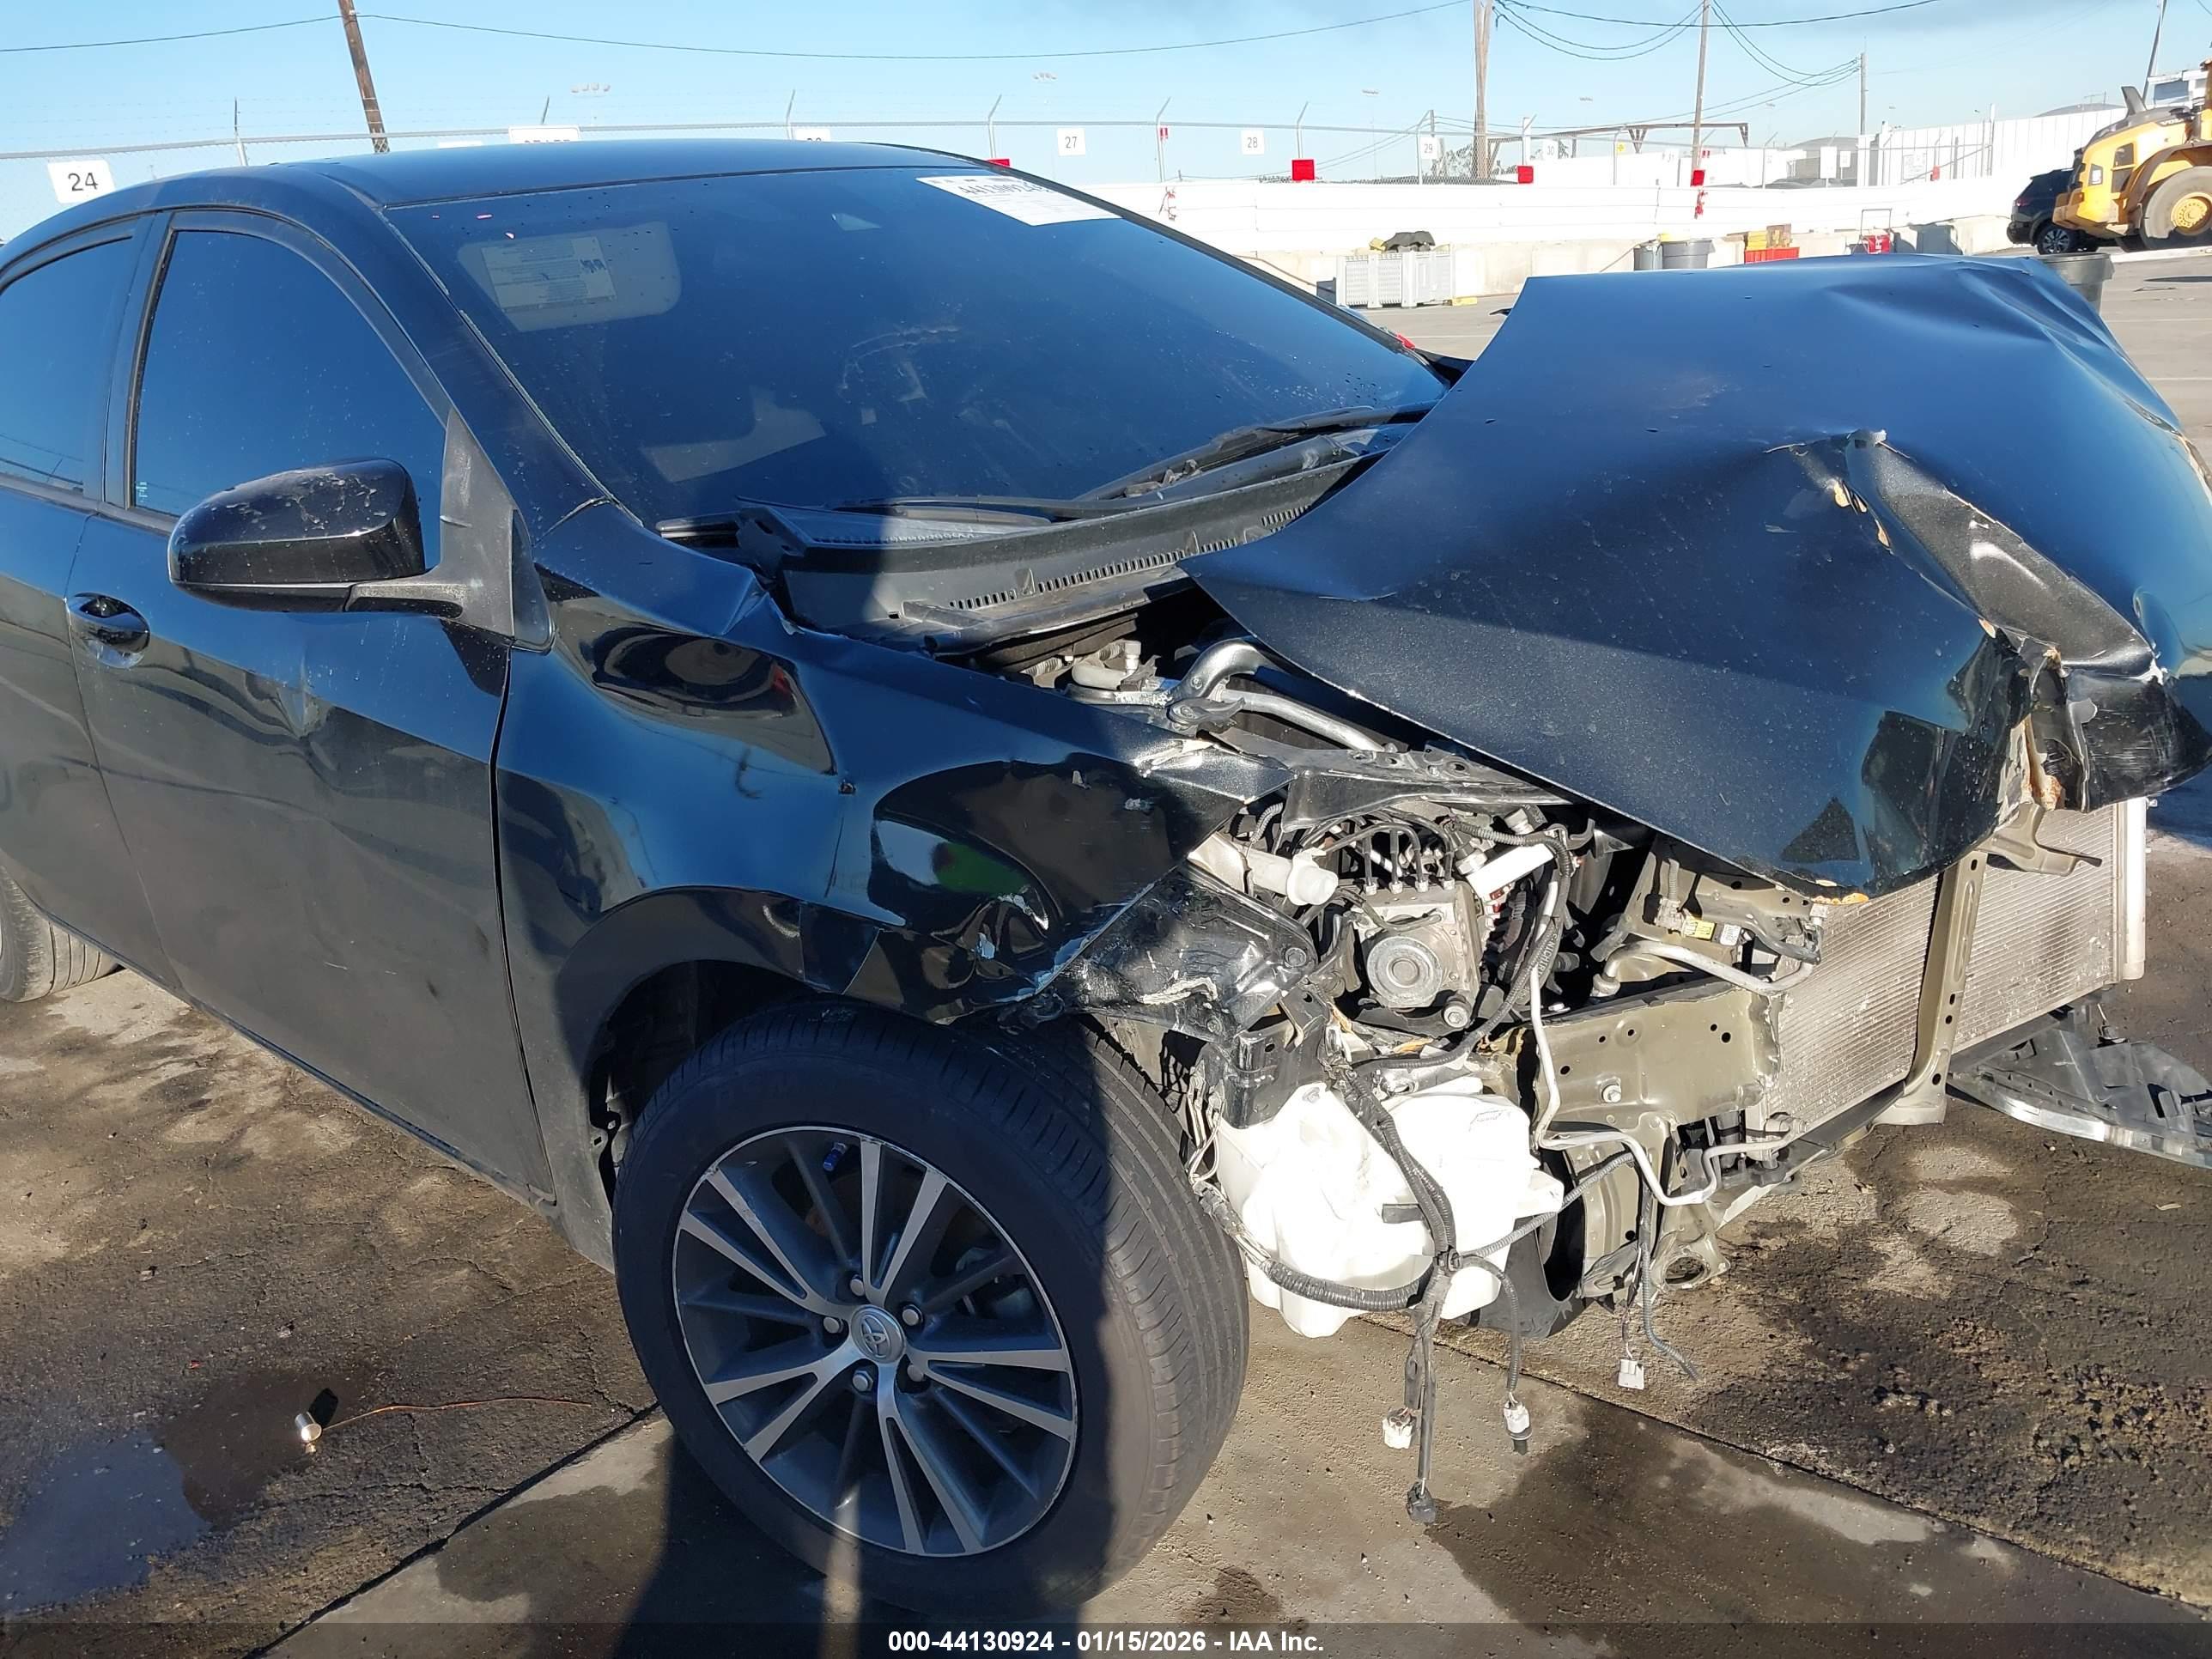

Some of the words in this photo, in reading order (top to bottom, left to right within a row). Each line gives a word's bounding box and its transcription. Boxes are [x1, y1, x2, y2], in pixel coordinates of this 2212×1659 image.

[1065, 136, 1077, 149] 27
[1247, 137, 1258, 149] 28
[1424, 143, 1433, 154] 29
[68, 172, 99, 191] 24
